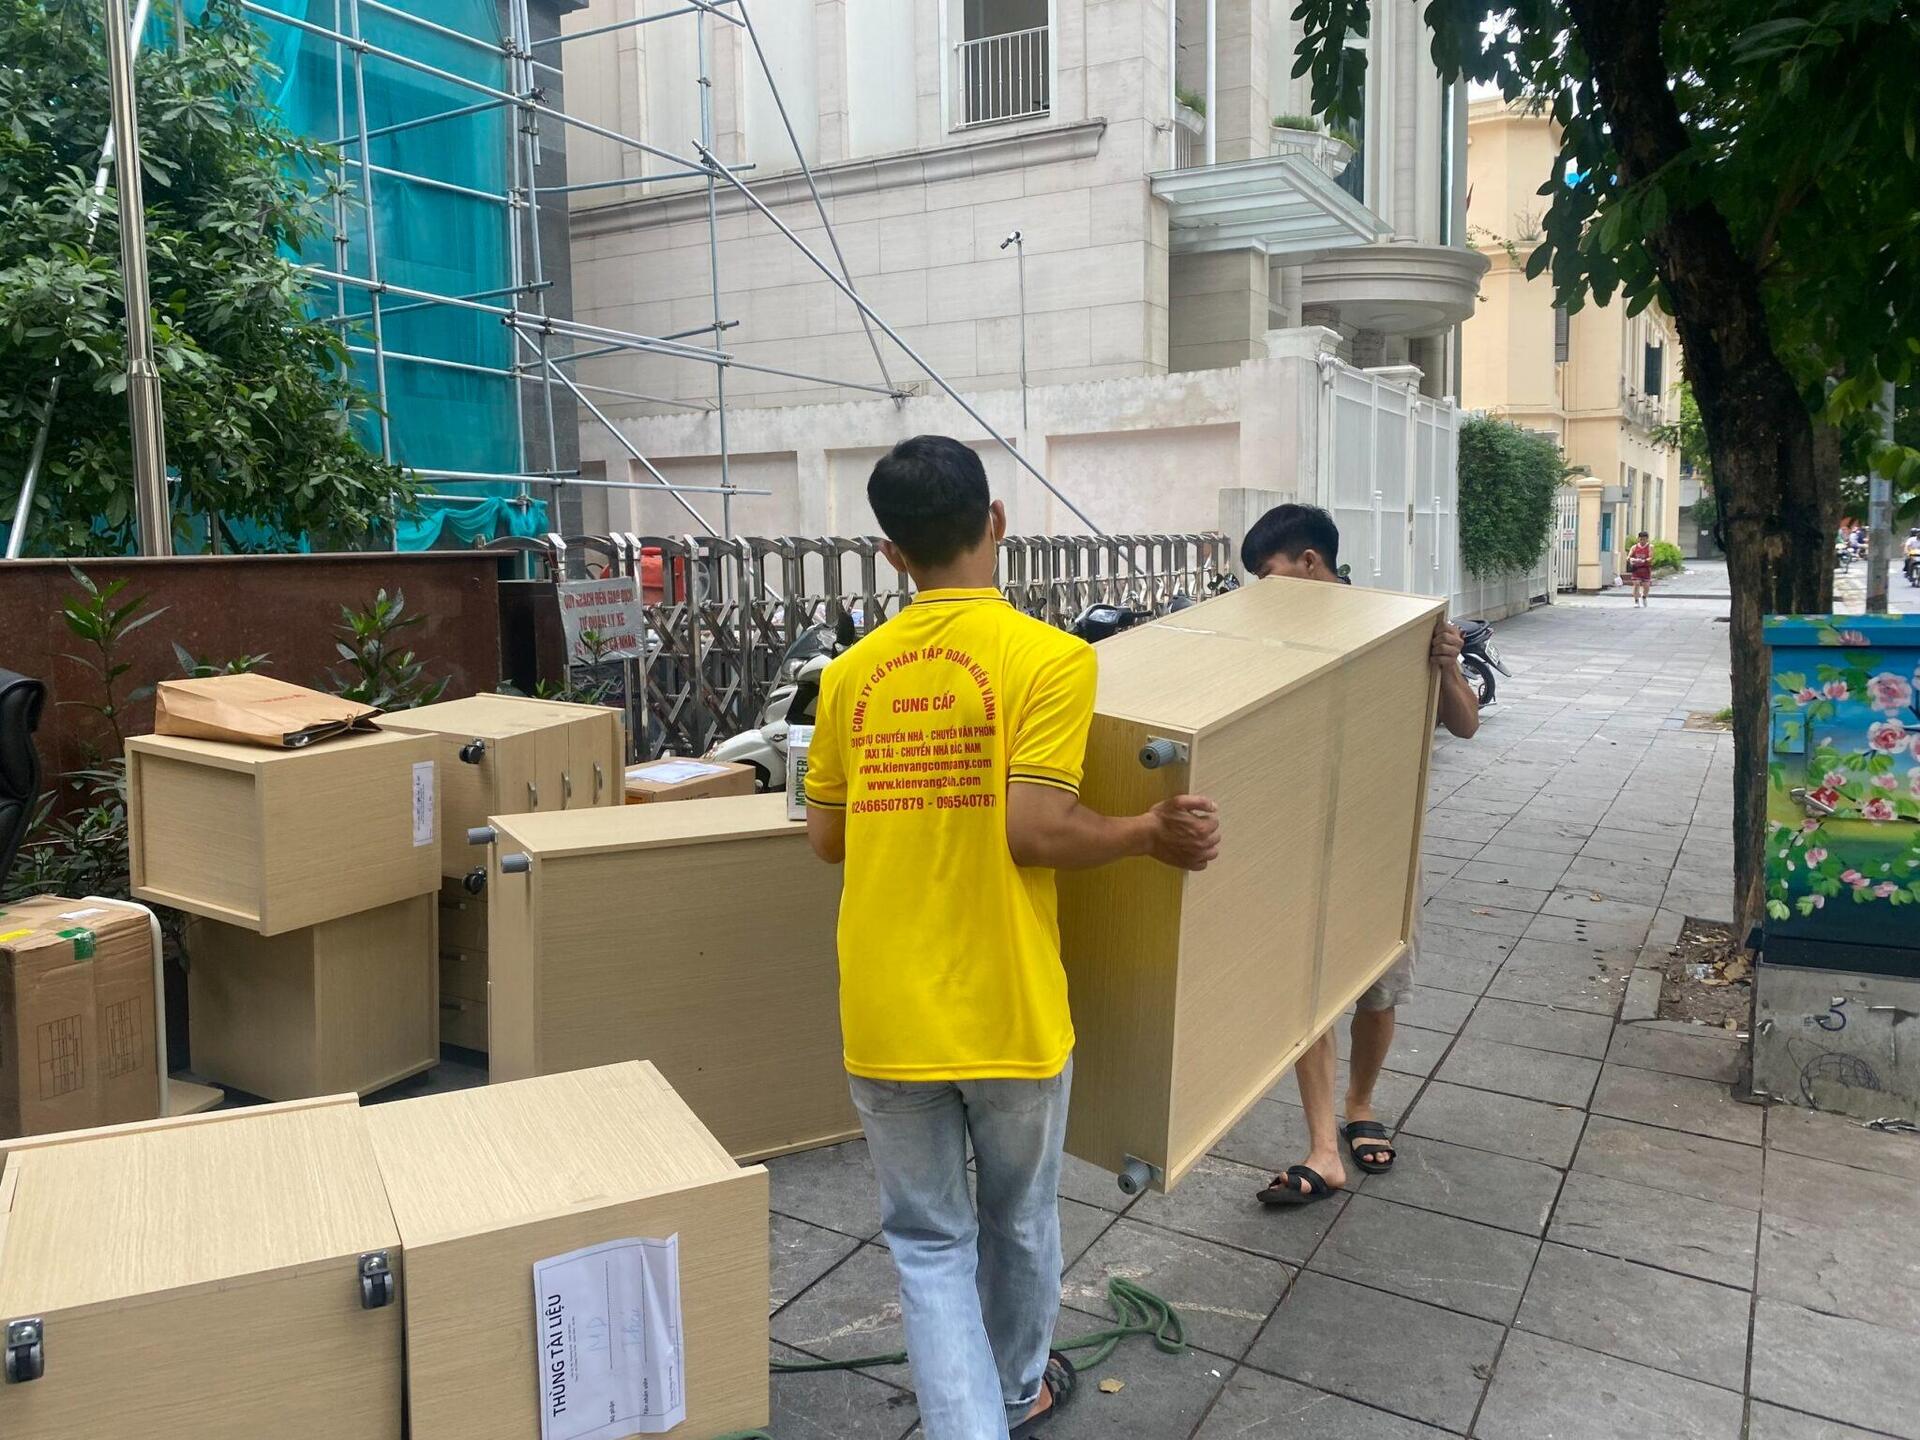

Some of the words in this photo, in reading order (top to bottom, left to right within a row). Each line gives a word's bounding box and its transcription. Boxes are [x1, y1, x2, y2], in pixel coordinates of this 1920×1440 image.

[861, 683, 873, 697] TY
[922, 645, 943, 661] TẬP
[892, 697, 928, 714] CUNG
[933, 690, 956, 711] CẤP
[974, 723, 996, 737] PHÒN
[965, 742, 981, 754] NAM
[867, 775, 981, 791] www.kienvang24h.com
[936, 793, 997, 809] 096540787
[545, 1294, 565, 1328] LIỆU
[546, 1329, 564, 1360] TÀI
[549, 1360, 566, 1418] THÙNG
